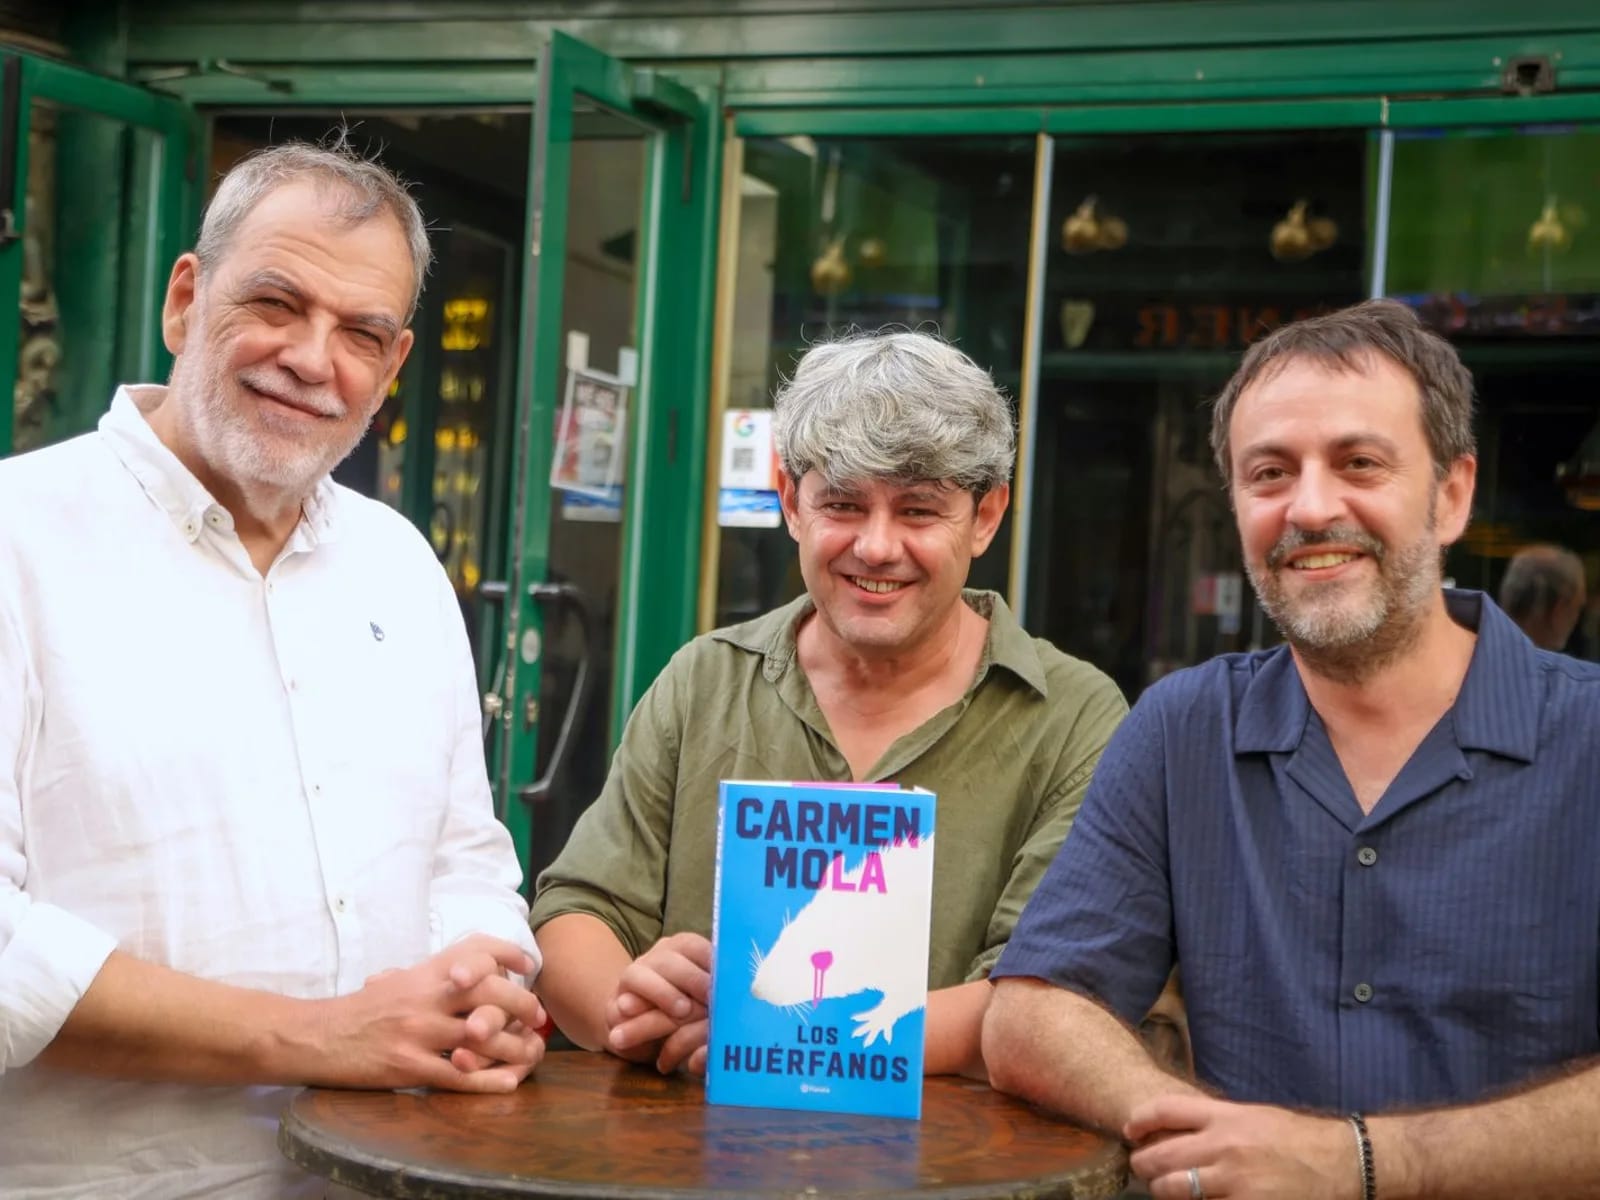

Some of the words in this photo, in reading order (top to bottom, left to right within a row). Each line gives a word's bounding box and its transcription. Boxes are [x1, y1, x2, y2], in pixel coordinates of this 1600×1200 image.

[736, 797, 921, 848] CARMEN
[764, 847, 888, 894] MOLA
[797, 1025, 839, 1045] LOS
[723, 1043, 909, 1083] HUÉRFANOS
